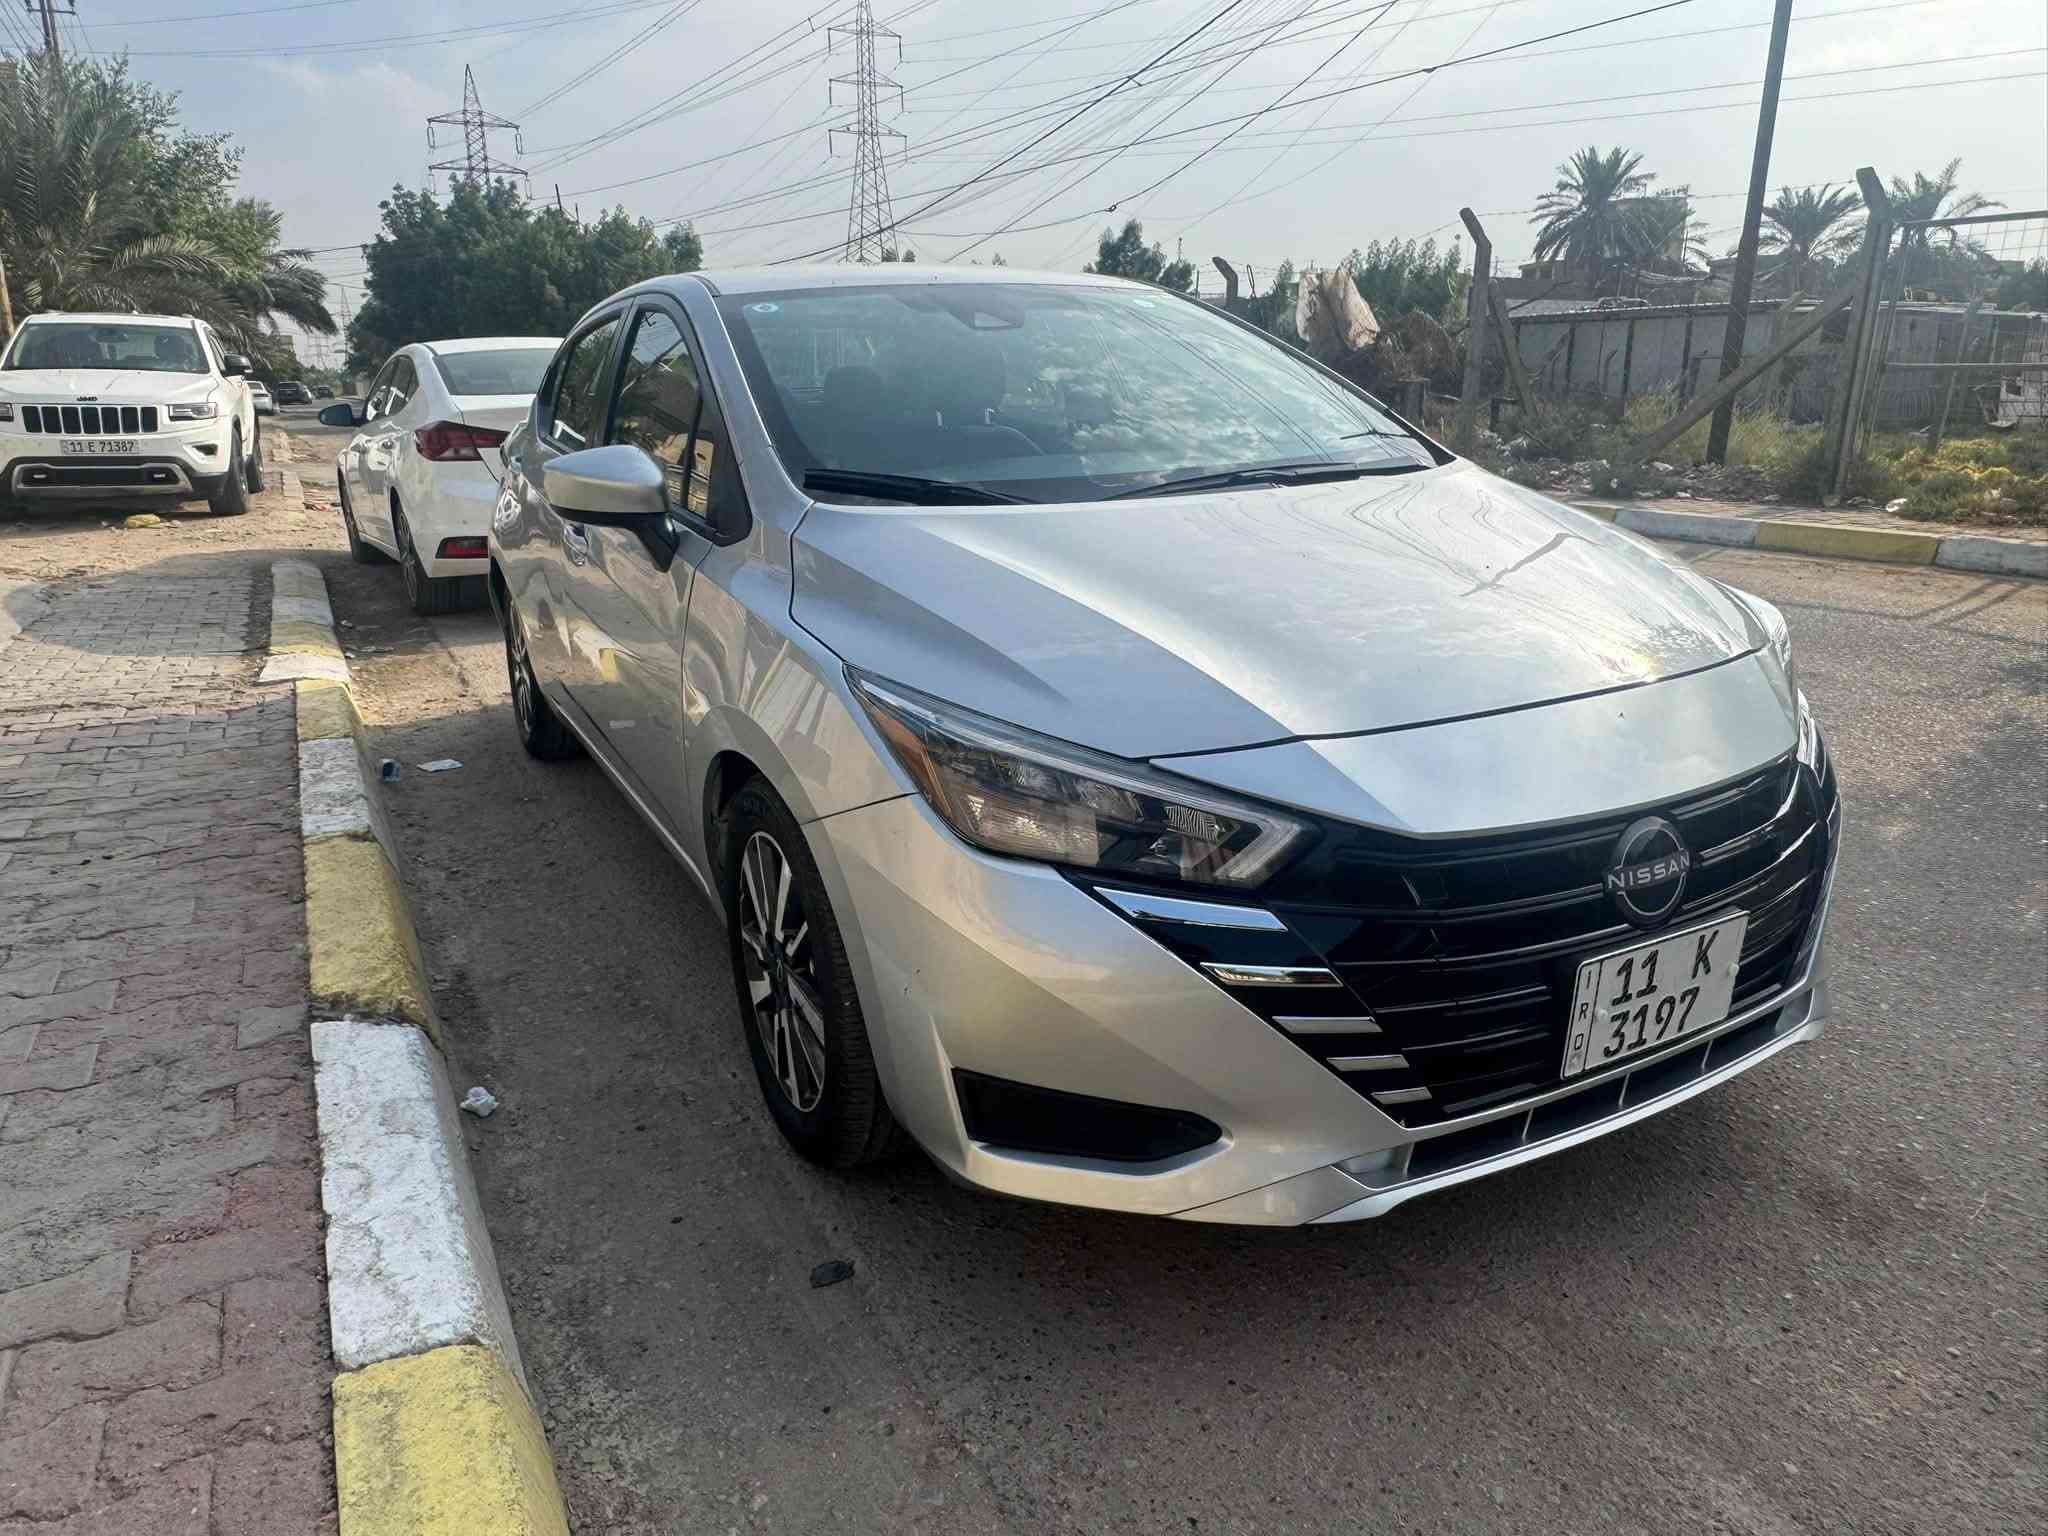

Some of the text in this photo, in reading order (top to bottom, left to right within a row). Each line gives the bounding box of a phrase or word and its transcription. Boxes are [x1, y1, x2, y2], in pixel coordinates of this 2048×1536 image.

[69, 441, 82, 453] 11
[100, 441, 134, 452] 71387
[1608, 851, 1690, 888] NISSAN
[1612, 929, 1719, 1006] 11 K
[1603, 986, 1700, 1057] 3197
